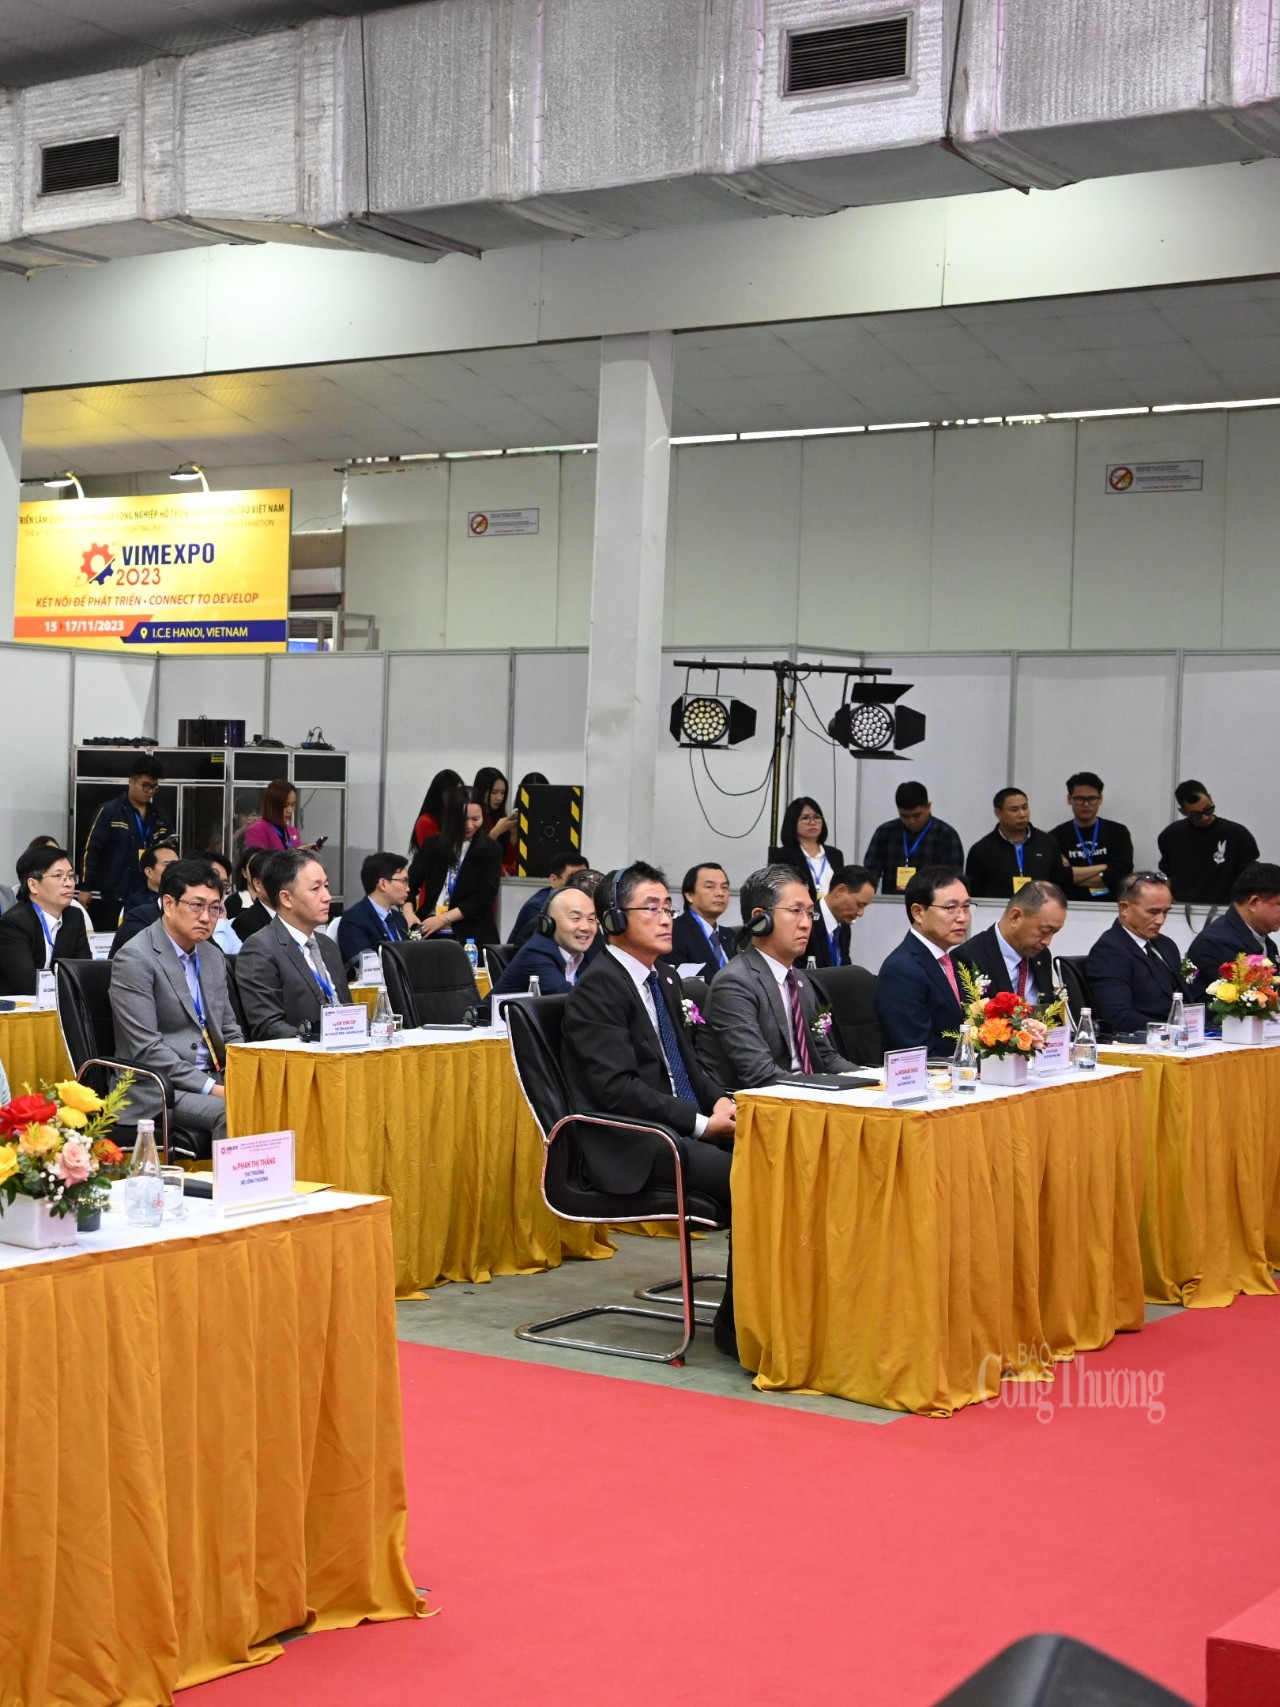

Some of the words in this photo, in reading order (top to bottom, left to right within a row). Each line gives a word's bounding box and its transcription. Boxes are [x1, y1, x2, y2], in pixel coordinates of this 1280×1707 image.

[252, 504, 266, 514] VIỆT
[268, 504, 285, 512] NAM
[122, 542, 215, 566] VIMEXPO
[116, 567, 161, 586] 2023
[88, 594, 112, 606] PHÁT
[149, 594, 195, 606] CONNECT
[198, 594, 211, 604] TO
[212, 592, 259, 604] DEVELOP
[44, 621, 58, 632] 15
[65, 620, 124, 632] 17/11/2023
[172, 628, 205, 639] HANOI,
[207, 626, 248, 638] VIETNAM
